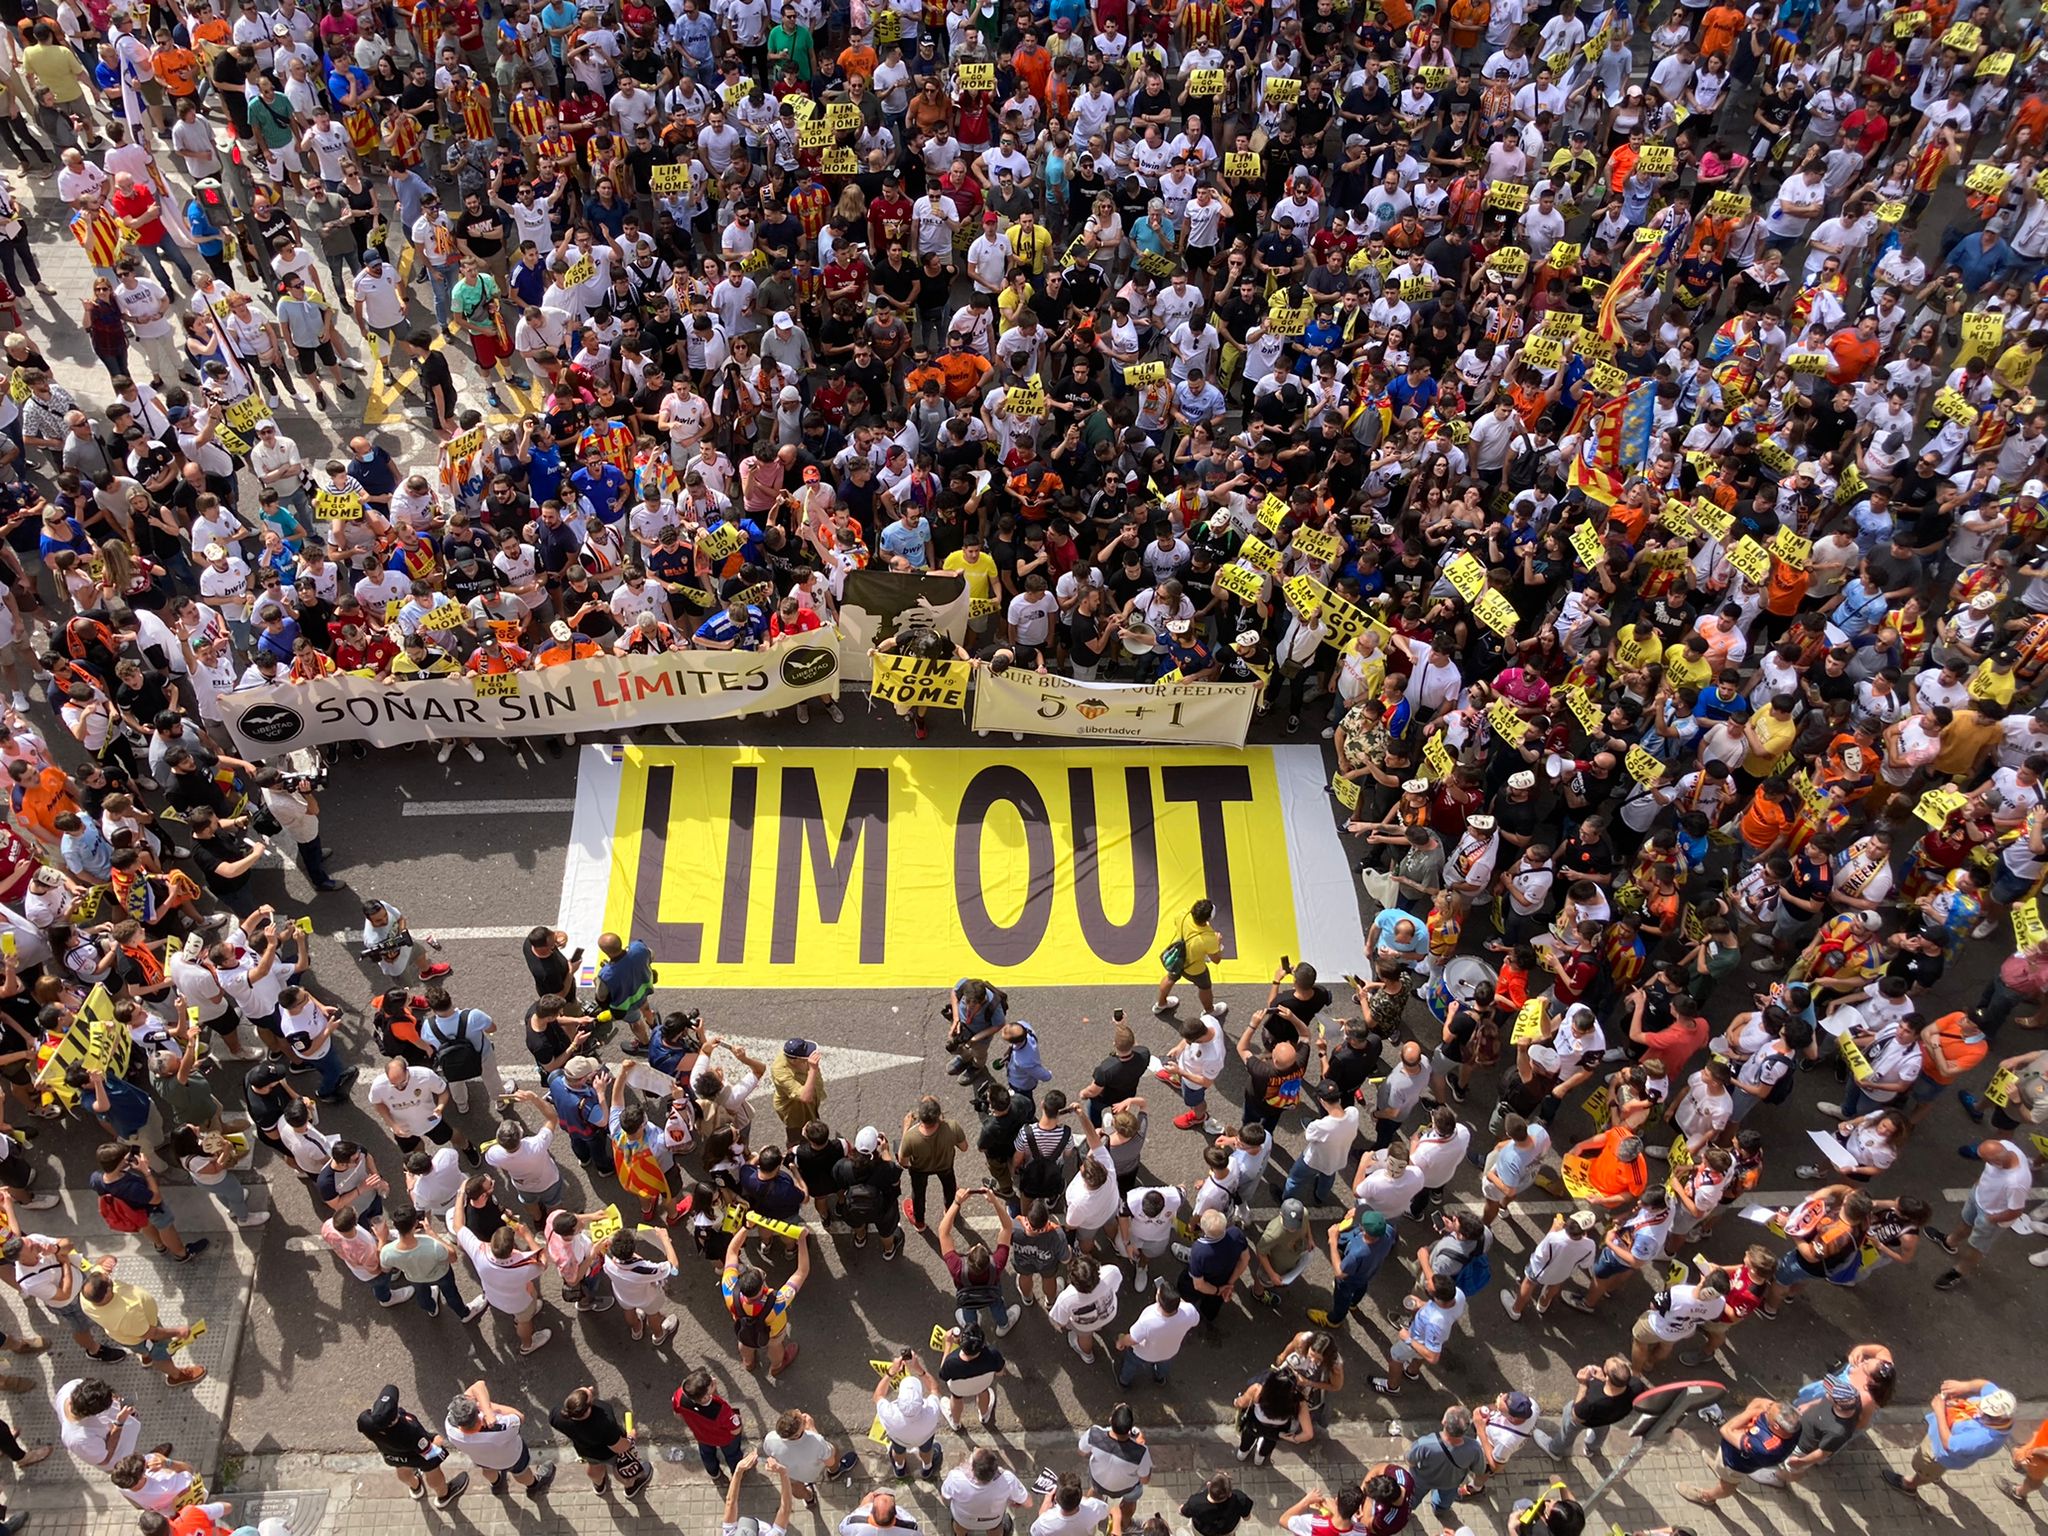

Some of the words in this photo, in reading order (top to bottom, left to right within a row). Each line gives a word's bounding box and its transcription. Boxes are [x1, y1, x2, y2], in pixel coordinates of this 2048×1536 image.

[967, 65, 987, 74] LIM
[1197, 70, 1217, 79] LIM
[1425, 68, 1444, 76] LIM
[730, 82, 748, 94] LIM
[961, 80, 993, 88] HOME
[1192, 85, 1223, 93] HOME
[1272, 80, 1293, 89] LIM
[1265, 93, 1296, 101] HOME
[833, 105, 853, 114] LIM
[805, 121, 825, 130] LIM
[801, 135, 833, 145] HOME
[828, 150, 848, 158] LIM
[1233, 154, 1253, 162] LIM
[1648, 148, 1668, 157] LIM
[660, 166, 680, 175] LIM
[824, 164, 855, 172] HOME
[1140, 160, 1160, 170] bwin
[1640, 163, 1671, 172] HOME
[1226, 168, 1258, 176] HOME
[1981, 167, 2002, 180] LIM
[655, 182, 690, 190] HOME
[1498, 184, 1520, 194] LIM
[1968, 179, 2001, 193] HOME
[1489, 196, 1521, 209] HOME
[1720, 194, 1743, 204] LIM
[1710, 207, 1745, 217] HOME
[1498, 248, 1520, 257] LIM
[1149, 252, 1170, 267] LIM
[1490, 263, 1523, 273] HOME
[1403, 277, 1424, 288] LIM
[125, 293, 145, 303] VALENCIA
[1401, 290, 1431, 301] HOME
[1277, 311, 1300, 319] LIM
[1552, 313, 1574, 322] LIM
[1964, 314, 2001, 324] HOME
[1270, 324, 1302, 334] HOME
[1543, 327, 1575, 337] HOME
[1555, 322, 1566, 330] GO
[1969, 330, 1992, 339] LIM
[1534, 338, 1557, 351] LIM
[1537, 349, 1549, 357] GO
[1575, 344, 1609, 358] HOME
[1523, 352, 1557, 368] HOME
[1796, 356, 1819, 365] LIM
[1132, 364, 1156, 375] LIM
[1013, 390, 1038, 399] LIM
[232, 399, 253, 417] LIM
[1007, 405, 1043, 415] HOME
[1181, 405, 1203, 416] bwin
[1951, 401, 1962, 410] GO
[243, 409, 254, 418] GO
[1935, 400, 1970, 425] HOME
[237, 407, 270, 432] HOME
[456, 434, 477, 447] LIM
[1769, 446, 1790, 461] LIM
[324, 495, 350, 503] LIM
[1267, 495, 1283, 512] LIM
[318, 509, 360, 518] HOME
[1267, 508, 1274, 516] GO
[1703, 503, 1726, 520] LIM
[1258, 512, 1277, 532] HOME
[1674, 515, 1686, 525] GO
[1694, 512, 1725, 537] HOME
[1660, 518, 1692, 539] HOME
[705, 530, 728, 548] LIM
[1306, 530, 1332, 544] LIM
[1585, 526, 1600, 548] LIM
[1783, 532, 1805, 548] LIM
[712, 540, 744, 559] HOME
[716, 540, 728, 548] GO
[1251, 541, 1275, 559] LIM
[1586, 541, 1594, 550] GO
[1783, 540, 1795, 553] GO
[1295, 540, 1333, 561] HOME
[1573, 536, 1595, 566] HOME
[1744, 541, 1768, 561] LIM
[1770, 542, 1803, 567] HOME
[1241, 552, 1274, 574] HOME
[1744, 553, 1756, 564] GO
[1465, 560, 1485, 581] LIM
[1728, 551, 1761, 580] HOME
[1230, 567, 1254, 582] LIM
[1463, 571, 1473, 582] GO
[1445, 566, 1475, 599] HOME
[1220, 580, 1254, 600] HOME
[1297, 581, 1315, 601] LIM
[1284, 584, 1310, 618] HOME
[1492, 595, 1514, 615] LIM
[428, 604, 453, 621] LIM
[1322, 590, 1371, 629] LIM
[1489, 607, 1502, 617] GO
[1329, 612, 1357, 632] GO
[1475, 605, 1507, 634] HOME
[1623, 641, 1642, 656] LIM
[1620, 652, 1638, 664] OUT
[791, 662, 828, 680] LIBERTAD
[892, 656, 951, 676] LIM
[1671, 660, 1687, 677] LIM
[481, 674, 507, 682] LIM
[903, 675, 933, 685] GO
[1667, 670, 1682, 683] OUT
[315, 692, 486, 726] SOÑAR
[499, 686, 576, 721] SIN
[592, 665, 769, 707] LÍMITES
[477, 687, 517, 696] HOME
[876, 686, 961, 705] HOME
[1172, 686, 1247, 696] FEELING
[1580, 690, 1598, 714] LIM
[1037, 694, 1067, 719] 5
[1168, 702, 1185, 727] 1
[1498, 705, 1519, 726] LIM
[1569, 700, 1593, 730] HOME
[252, 721, 294, 736] LIBERTAD
[1487, 713, 1517, 745] HOME
[1501, 717, 1511, 729] GO
[265, 728, 283, 738] VCF
[1632, 758, 1644, 771] GO
[1634, 748, 1657, 770] LIM
[628, 765, 890, 964] LIM
[954, 764, 1253, 967] OUT
[2025, 907, 2041, 934] LIM
[1843, 1041, 1861, 1067] LIM
